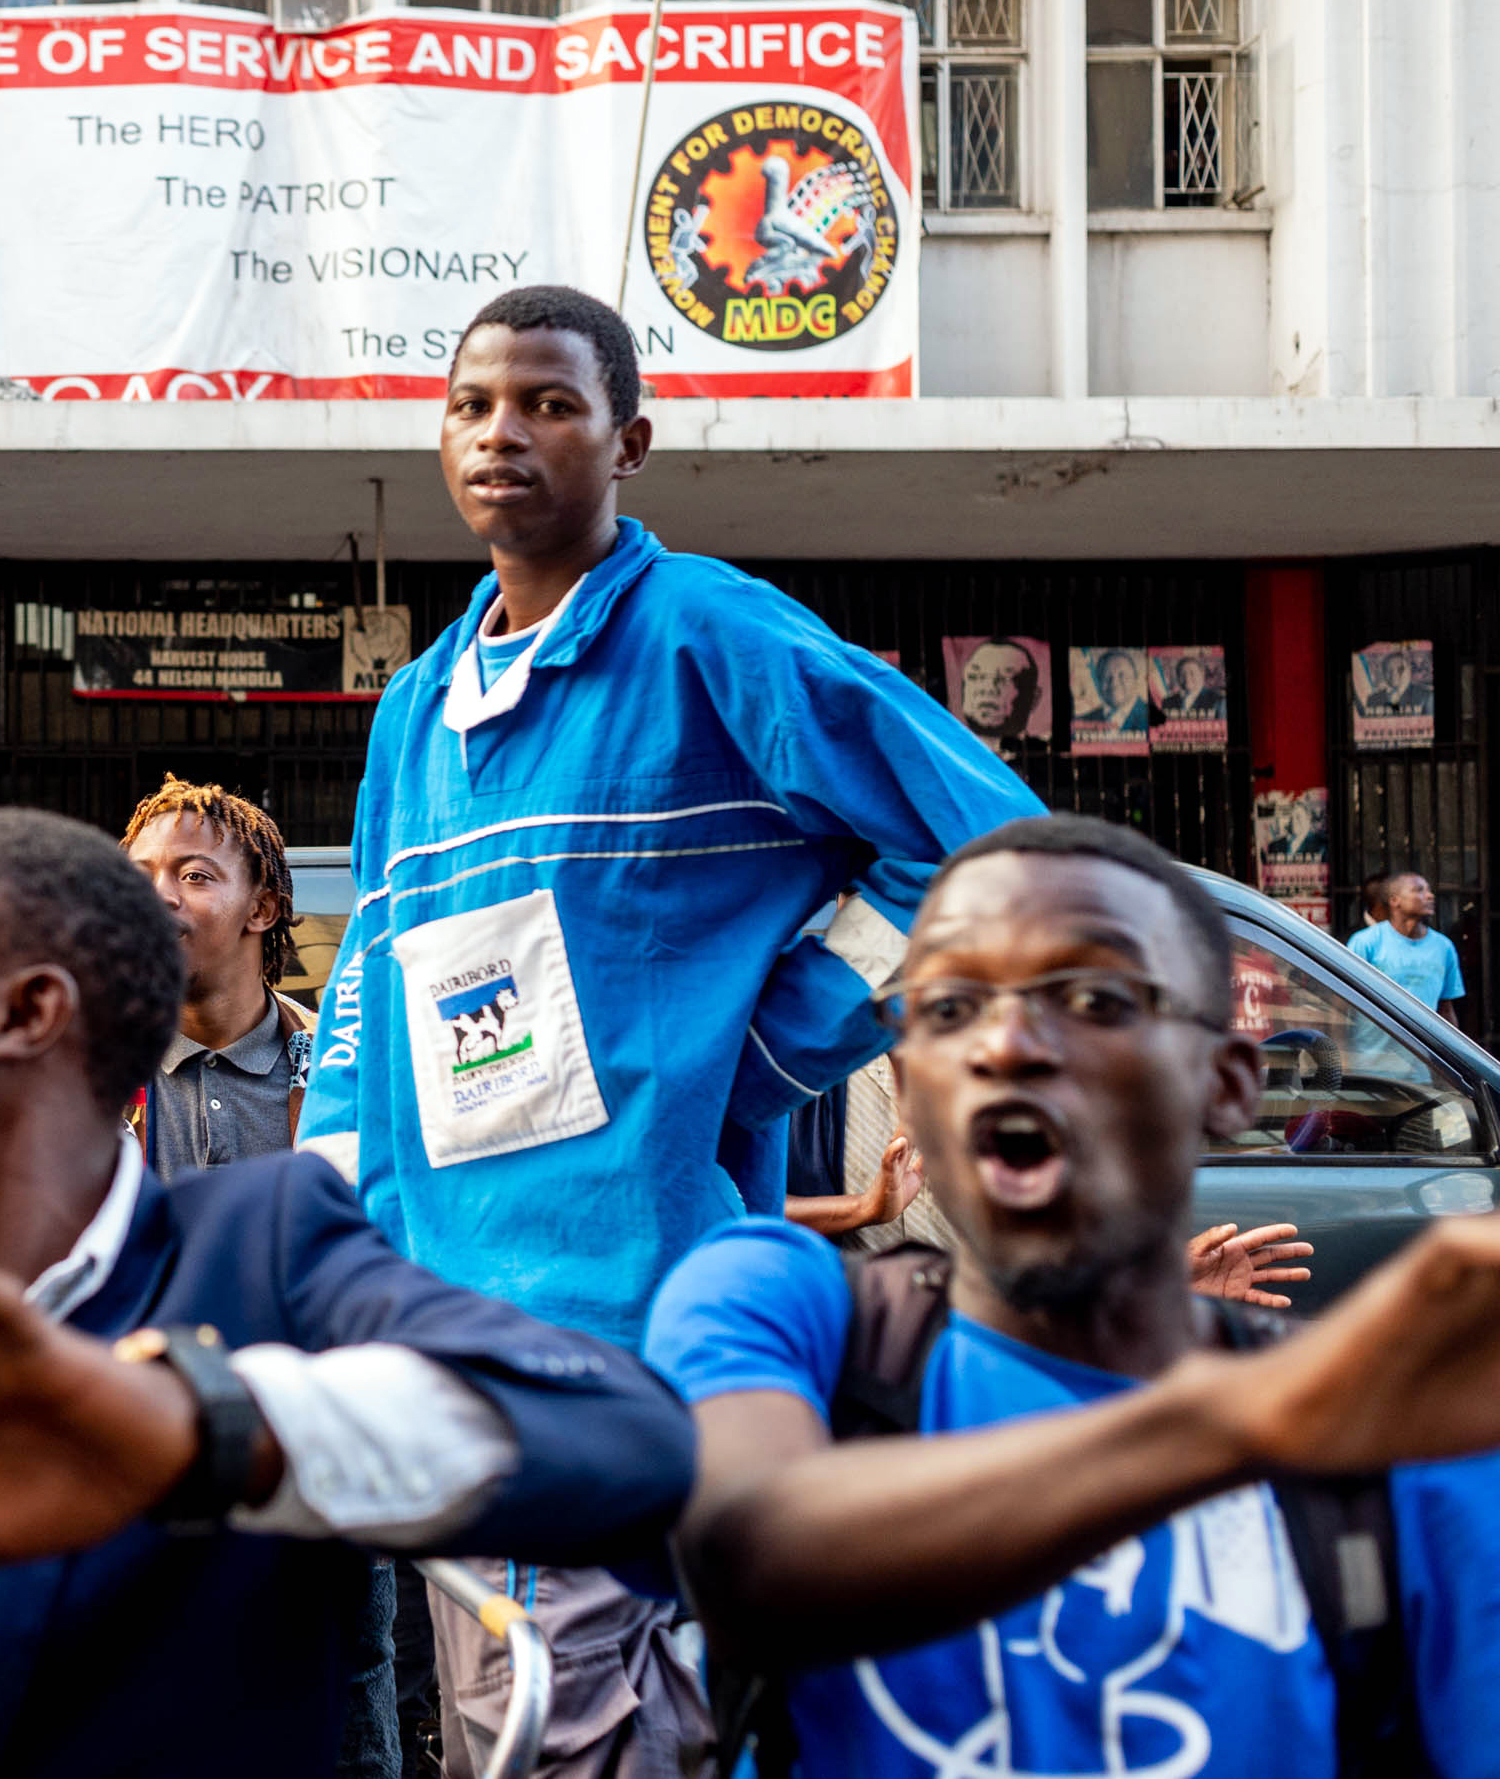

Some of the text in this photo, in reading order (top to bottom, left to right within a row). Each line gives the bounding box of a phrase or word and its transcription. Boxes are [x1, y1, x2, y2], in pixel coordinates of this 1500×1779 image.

[37, 29, 125, 73] OF
[144, 27, 392, 80] SERVICE
[407, 33, 535, 81] AND
[554, 22, 886, 80] SACRIFICE
[67, 115, 265, 151] The HERO
[156, 176, 397, 214] The PATRIOT
[648, 105, 896, 328] MOVEMENT FOR DEMOCRATIC CHANGE
[231, 248, 528, 284] The VISIONARY
[722, 293, 837, 342] MDC
[341, 327, 408, 359] The
[78, 610, 341, 640] NATIONAL HEADQUARTERS
[151, 650, 267, 668] HARVEST HOUSE
[157, 670, 213, 686] NELSON
[215, 670, 283, 687] MANDELA
[353, 672, 391, 689] MD
[428, 958, 513, 998] DAIRIBORD
